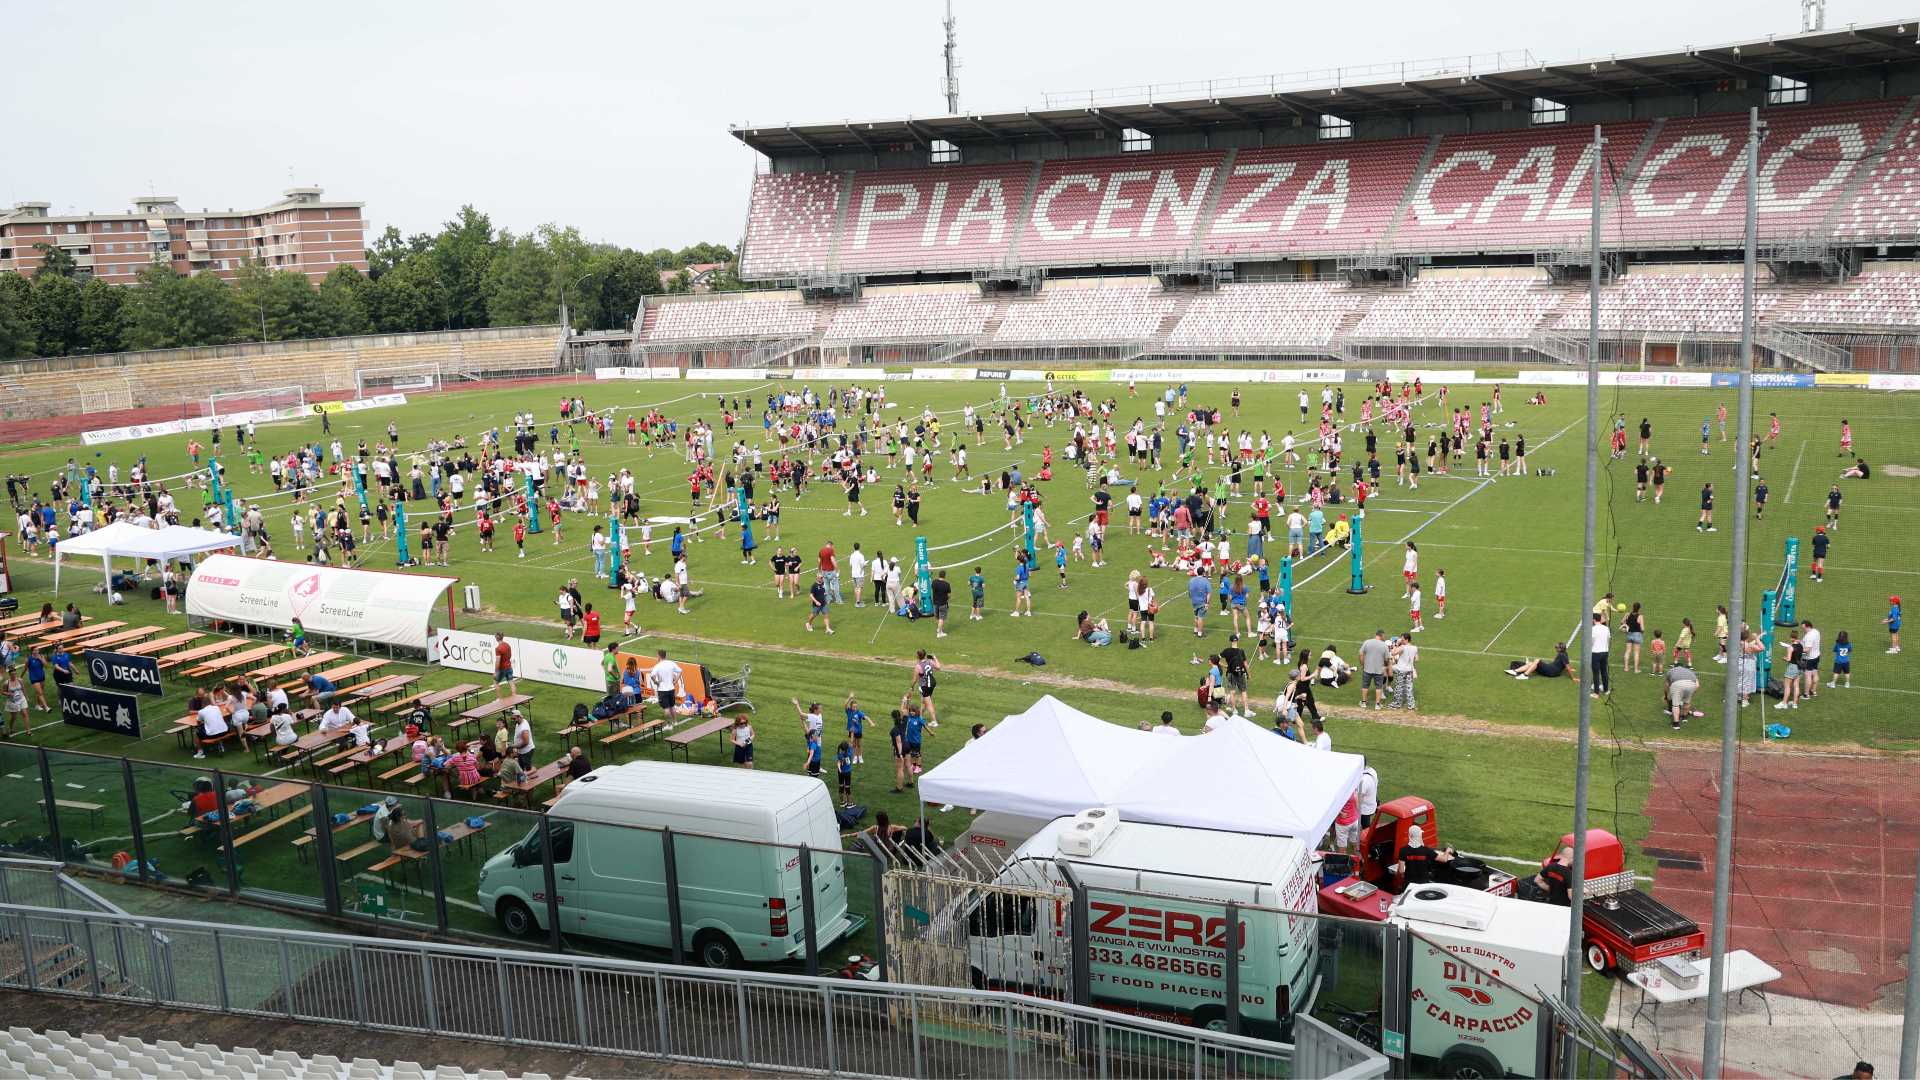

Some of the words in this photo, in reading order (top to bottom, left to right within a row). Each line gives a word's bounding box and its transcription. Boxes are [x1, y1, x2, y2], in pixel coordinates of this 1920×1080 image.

[852, 158, 1350, 250] PIACENZA
[1410, 122, 1867, 226] CALCIO
[239, 592, 279, 608] ScreenLine
[319, 602, 365, 619] ScreenLine
[112, 664, 160, 685] DECAL
[62, 697, 112, 721] ACQUE
[1088, 935, 1135, 948] MANGIA
[1138, 941, 1145, 949] E
[1147, 942, 1171, 952] VIVI
[1173, 945, 1246, 962] NOSTRAO
[1088, 946, 1222, 978] 333.4626566
[1460, 946, 1471, 954] LE
[1474, 947, 1516, 970] QUATTRO
[1443, 960, 1502, 989] DITA
[1112, 975, 1155, 989] FOOD
[1160, 982, 1265, 1005] PIACENNO
[1426, 1005, 1534, 1033] CARPACCIO
